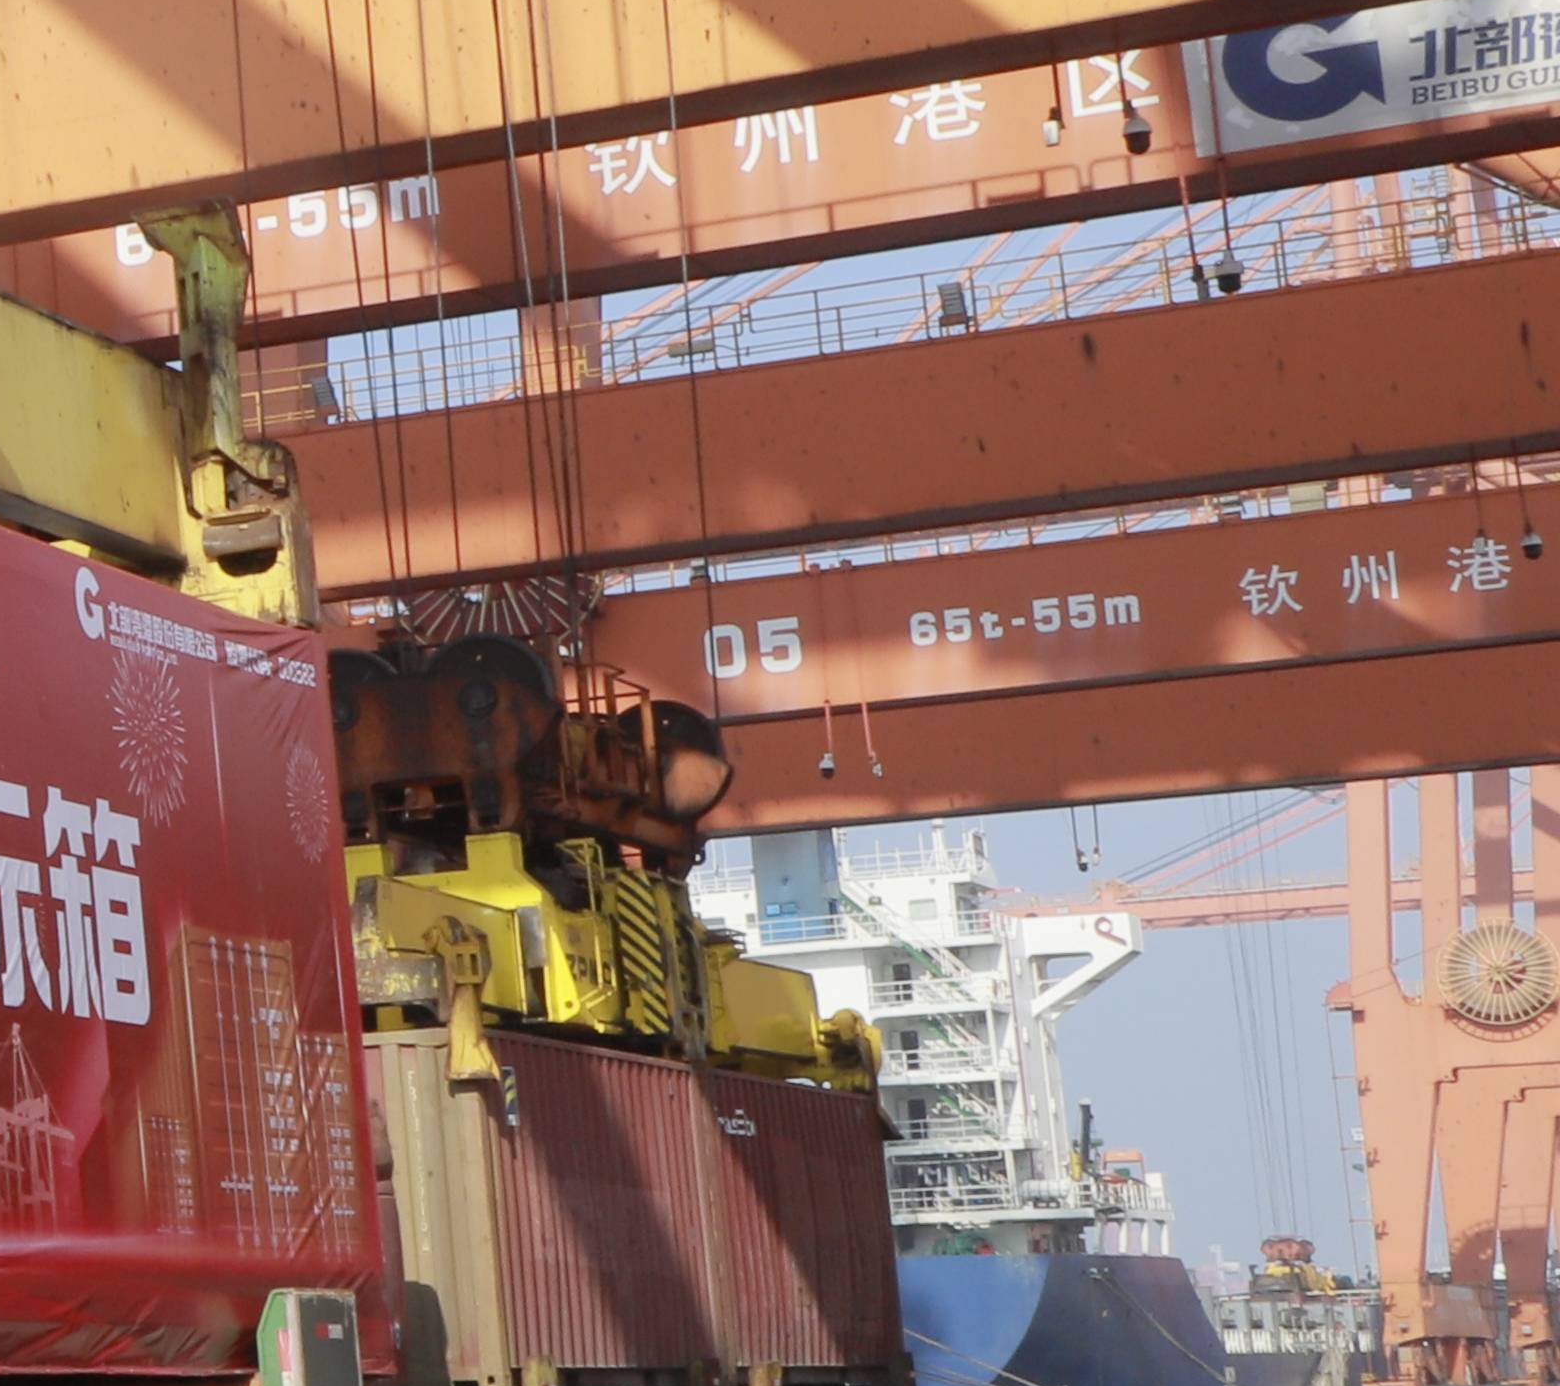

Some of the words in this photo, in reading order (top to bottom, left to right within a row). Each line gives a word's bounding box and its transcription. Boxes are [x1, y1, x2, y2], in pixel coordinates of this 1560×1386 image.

[1411, 73, 1500, 105] BEIBU
[703, 616, 804, 680] 05
[908, 592, 1142, 648] 65t-55m
